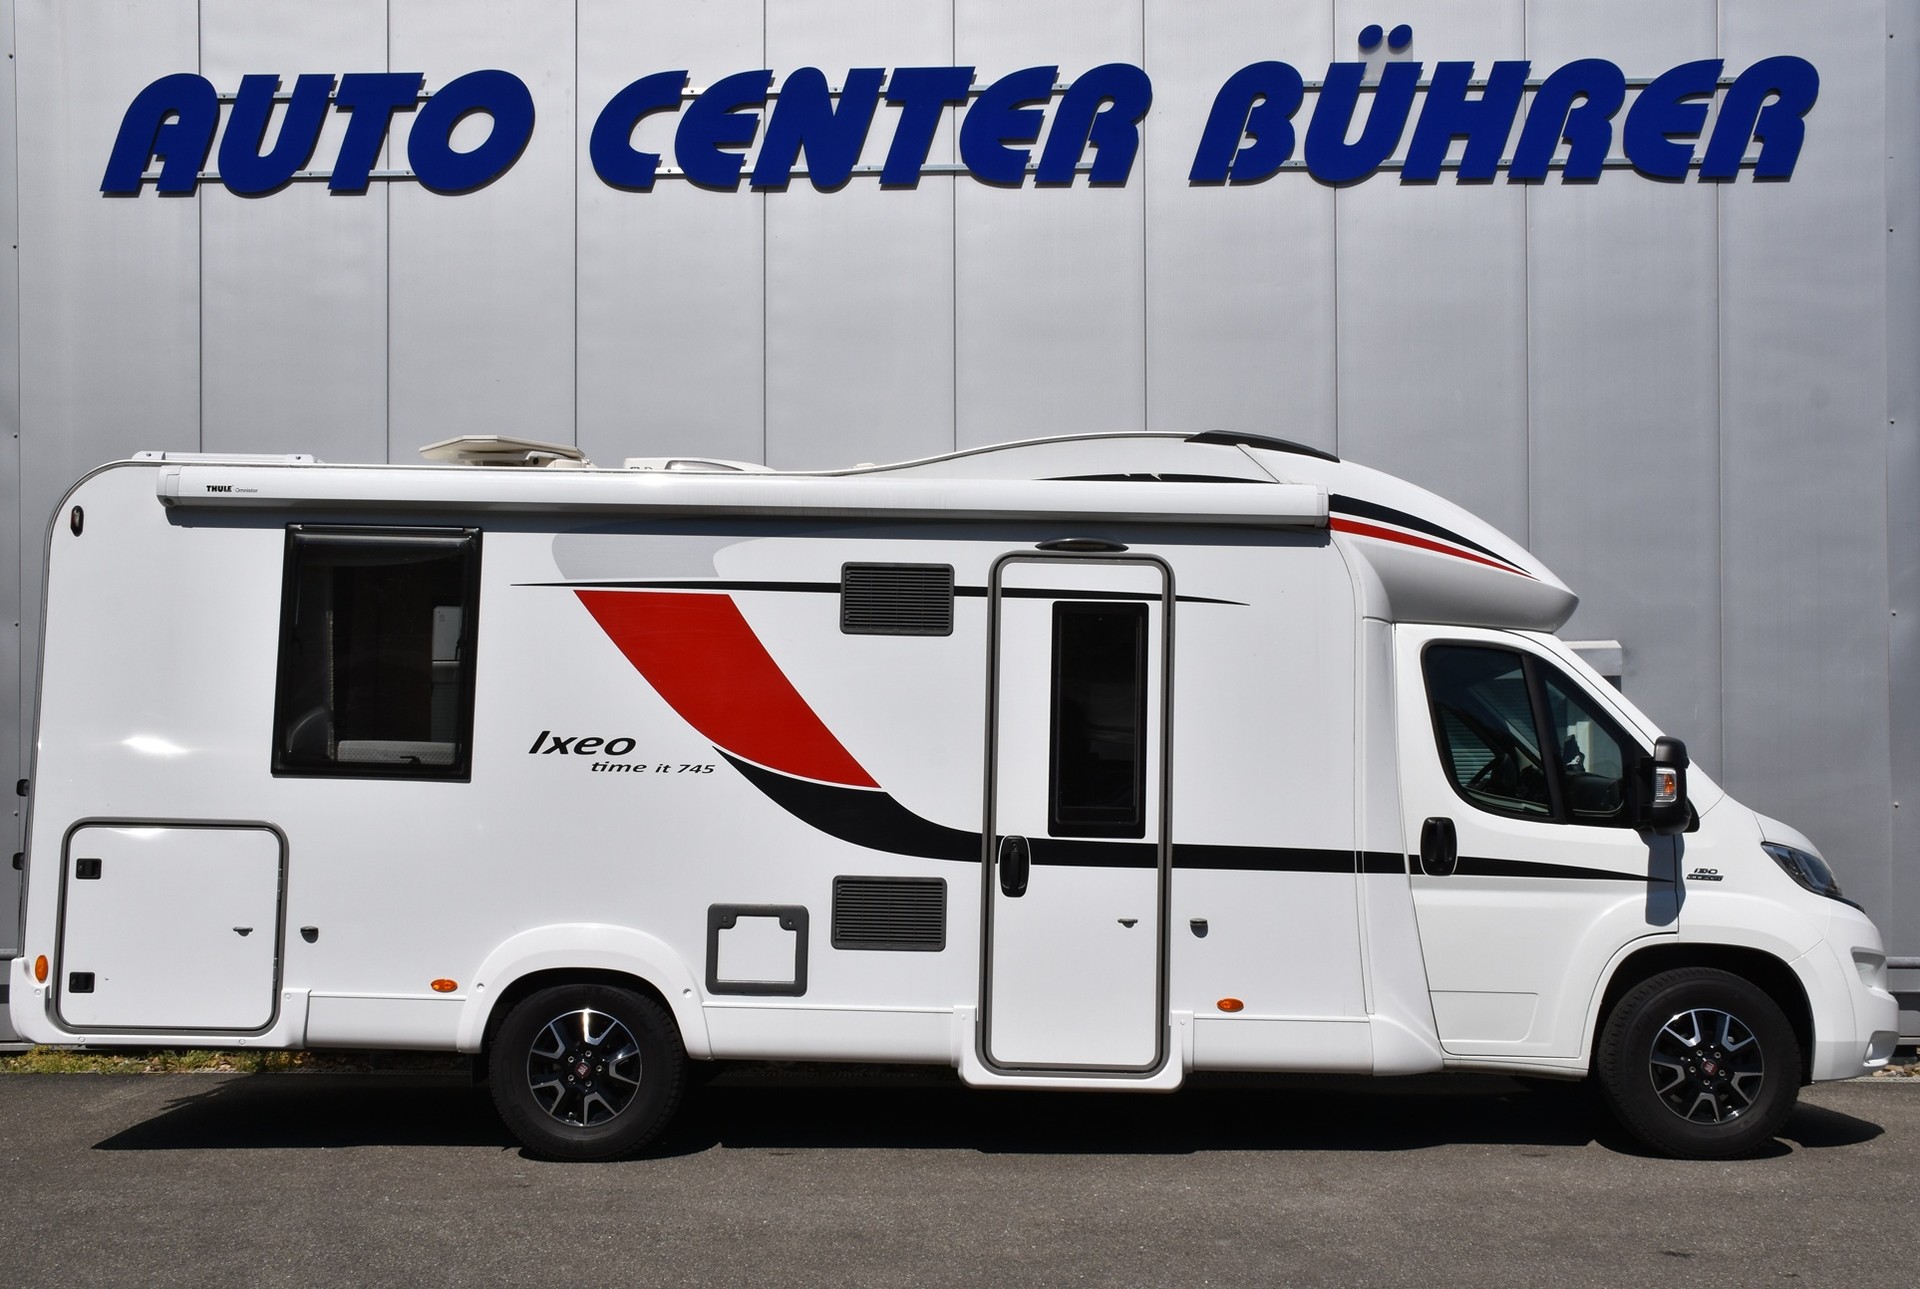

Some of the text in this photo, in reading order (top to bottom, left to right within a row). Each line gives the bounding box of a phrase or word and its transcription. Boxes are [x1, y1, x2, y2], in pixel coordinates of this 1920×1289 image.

[101, 24, 1820, 195] AUTO CENTER BÜHRER
[528, 730, 637, 756] Ixeo
[591, 760, 716, 774] time it 745
